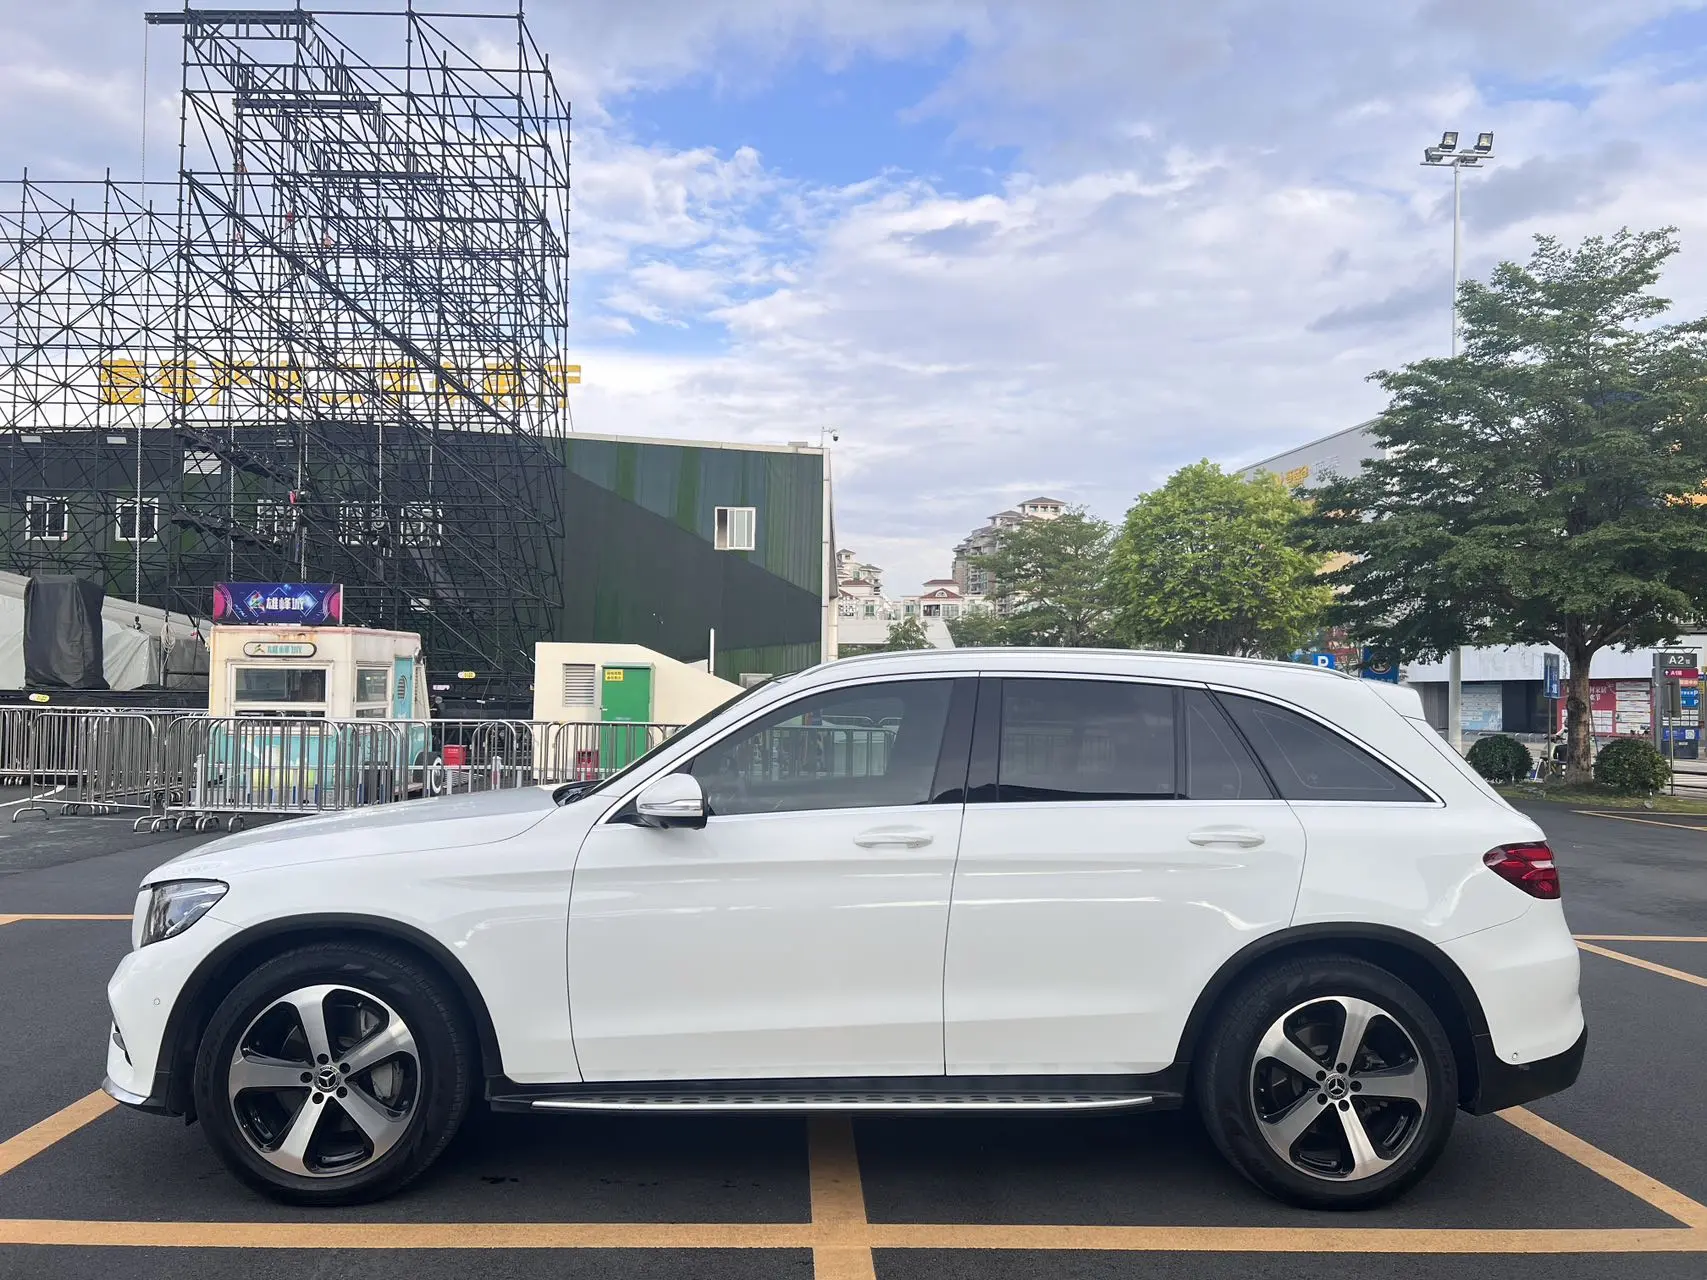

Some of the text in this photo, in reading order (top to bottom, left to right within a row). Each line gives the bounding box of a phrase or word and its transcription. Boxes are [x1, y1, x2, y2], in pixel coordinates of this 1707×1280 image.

[266, 597, 304, 610] 雄峰城
[1318, 656, 1329, 667] P
